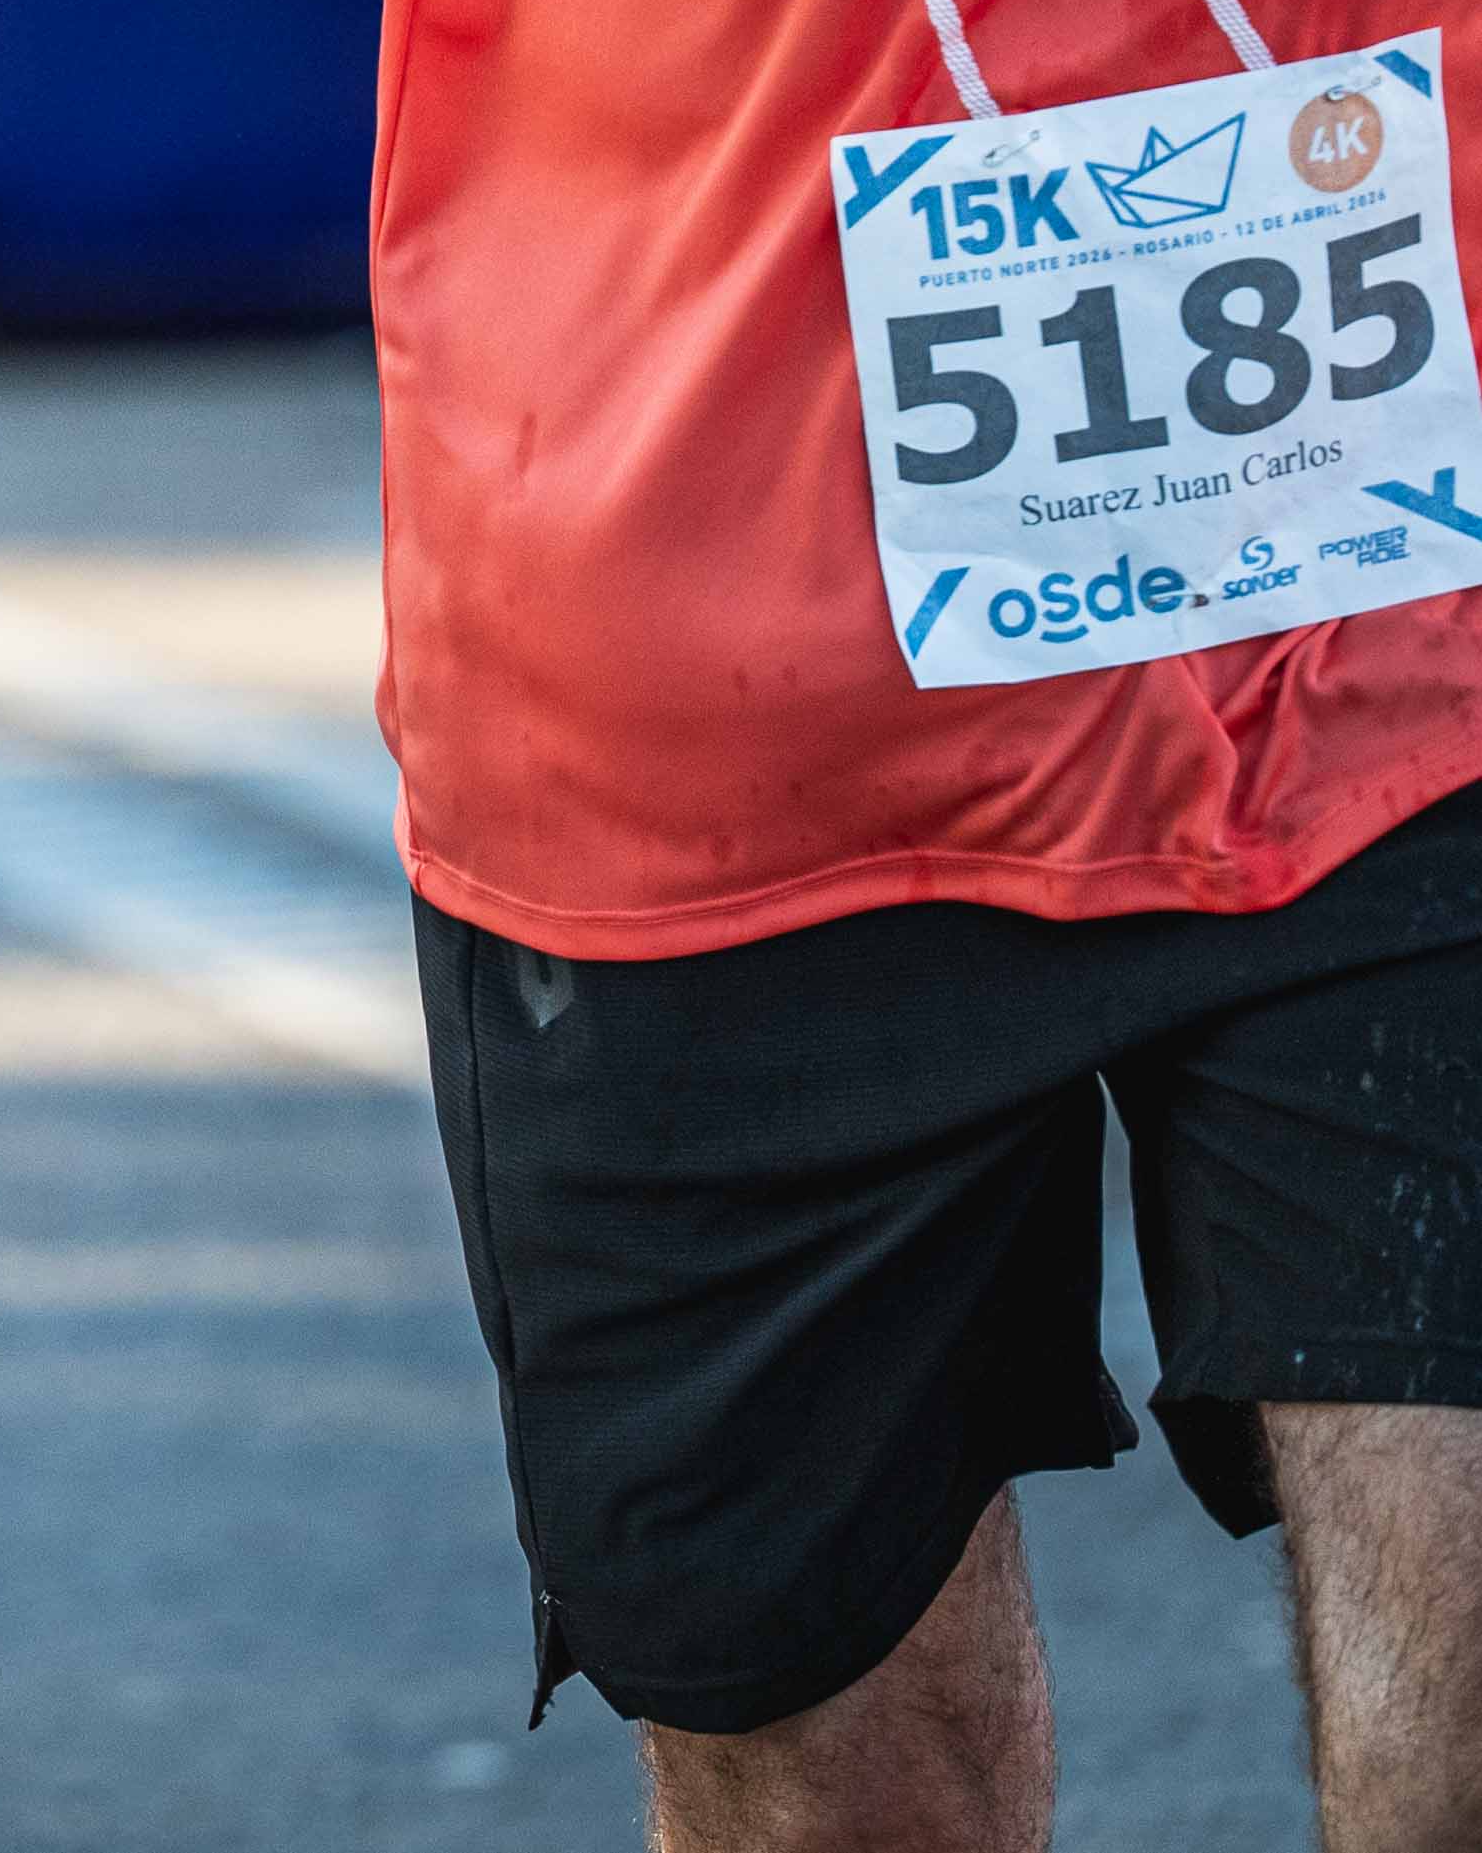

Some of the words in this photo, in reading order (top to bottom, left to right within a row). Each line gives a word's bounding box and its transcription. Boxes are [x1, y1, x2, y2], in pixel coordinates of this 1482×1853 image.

[1308, 116, 1367, 164] 4K
[910, 166, 1081, 260] 15K
[919, 266, 993, 288] PUERTO
[1000, 256, 1060, 278] NORTE
[1067, 248, 1112, 267] 2026
[1133, 229, 1214, 256] ROSARIO
[1235, 222, 1255, 237] 12
[1262, 216, 1284, 232] DE
[1291, 203, 1342, 225] ABRIL
[886, 212, 1435, 486] 5185
[1020, 486, 1141, 526] Suarez
[1153, 472, 1232, 507] Juan
[1242, 440, 1342, 486] Carlos
[1319, 525, 1408, 561] POWER
